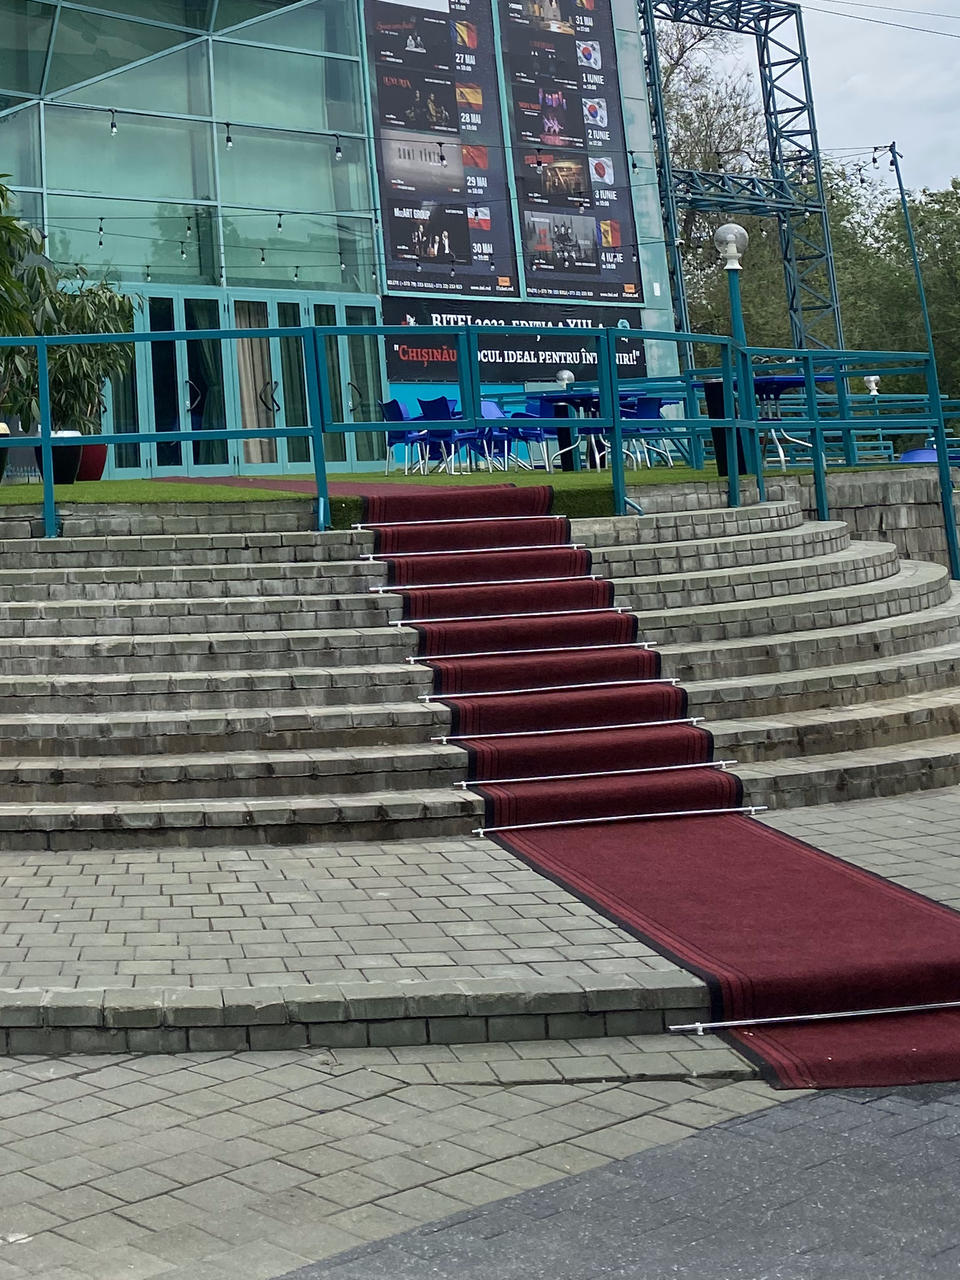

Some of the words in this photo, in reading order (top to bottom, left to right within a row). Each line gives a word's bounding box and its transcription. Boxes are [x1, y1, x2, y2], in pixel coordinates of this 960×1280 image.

[575, 15, 584, 25] 31
[455, 53, 464, 64] 27
[460, 112, 470, 123] 28
[587, 128, 593, 139] 2
[467, 176, 476, 187] 29
[594, 189, 600, 199] 3
[472, 242, 482, 253] 30
[601, 252, 606, 262] 4
[504, 350, 538, 364] IDEAL
[538, 351, 581, 364] PENTRU
